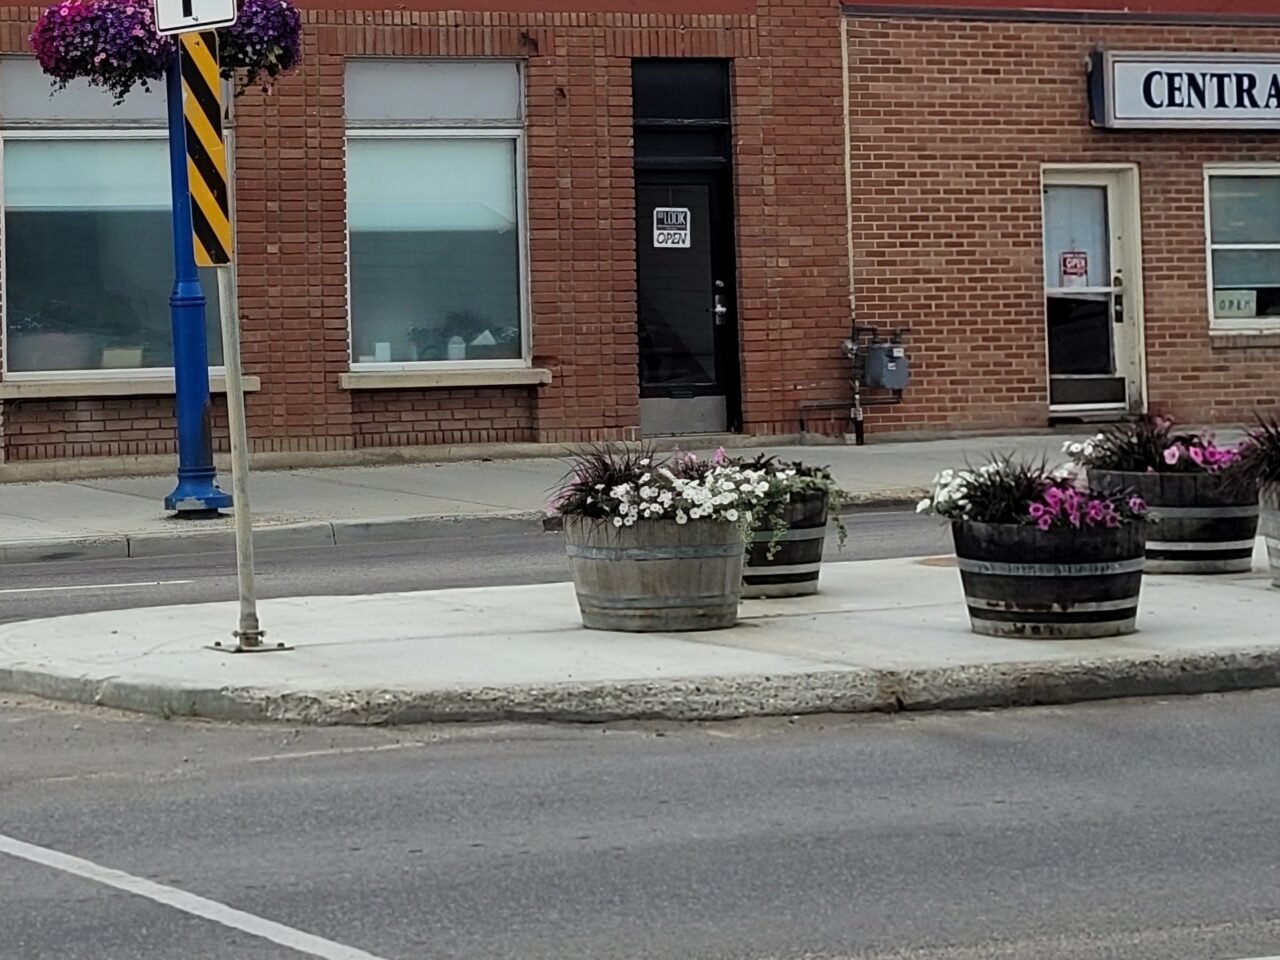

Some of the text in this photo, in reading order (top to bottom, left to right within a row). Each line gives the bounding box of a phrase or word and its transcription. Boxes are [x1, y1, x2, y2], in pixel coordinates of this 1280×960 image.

[1142, 70, 1280, 109] CENTRA
[664, 212, 686, 224] LOOK
[656, 233, 688, 244] OPEN
